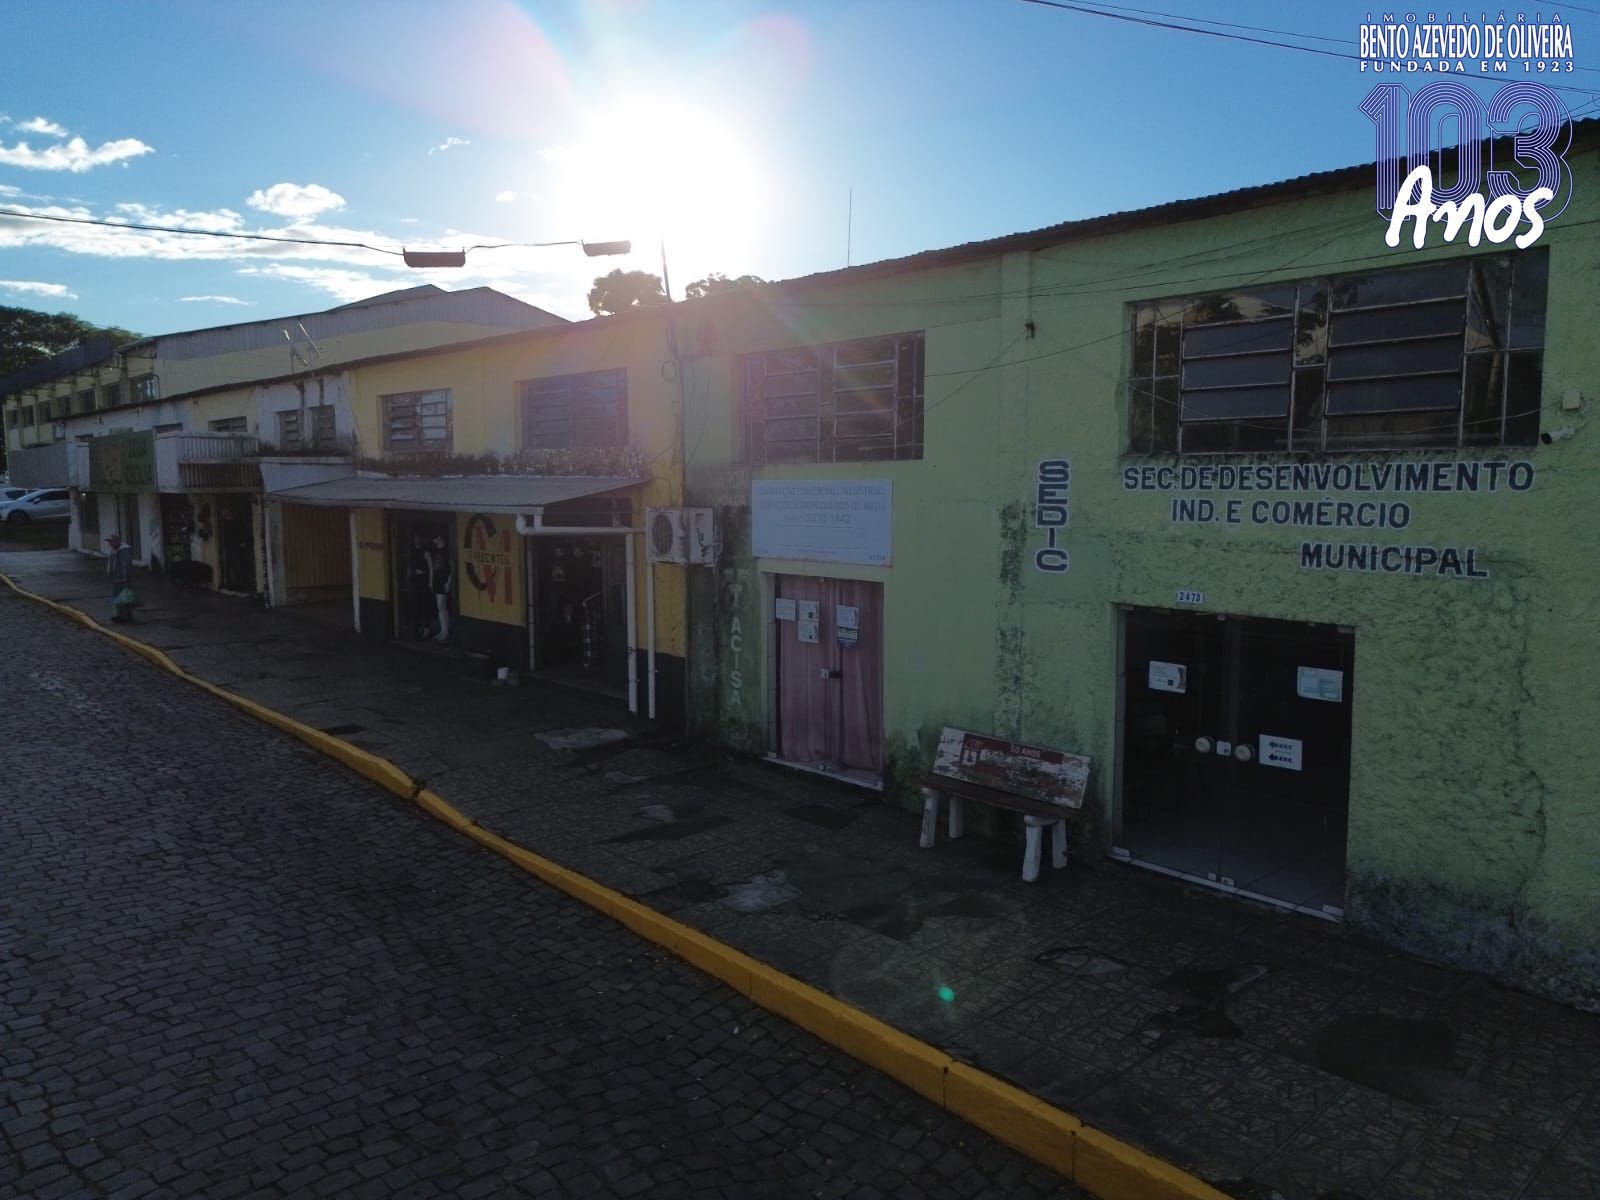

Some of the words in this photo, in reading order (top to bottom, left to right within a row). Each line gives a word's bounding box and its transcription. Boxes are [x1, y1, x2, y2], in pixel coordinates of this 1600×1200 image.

[1182, 465, 1215, 491] DE
[1219, 462, 1535, 492] DESENVOLVIMENTO
[1035, 459, 1070, 573] SEDIC
[1172, 499, 1221, 523] IND.
[1228, 500, 1246, 525] E
[1254, 497, 1411, 529] COMÉRCIO
[1300, 543, 1489, 579] MUNICIPAL
